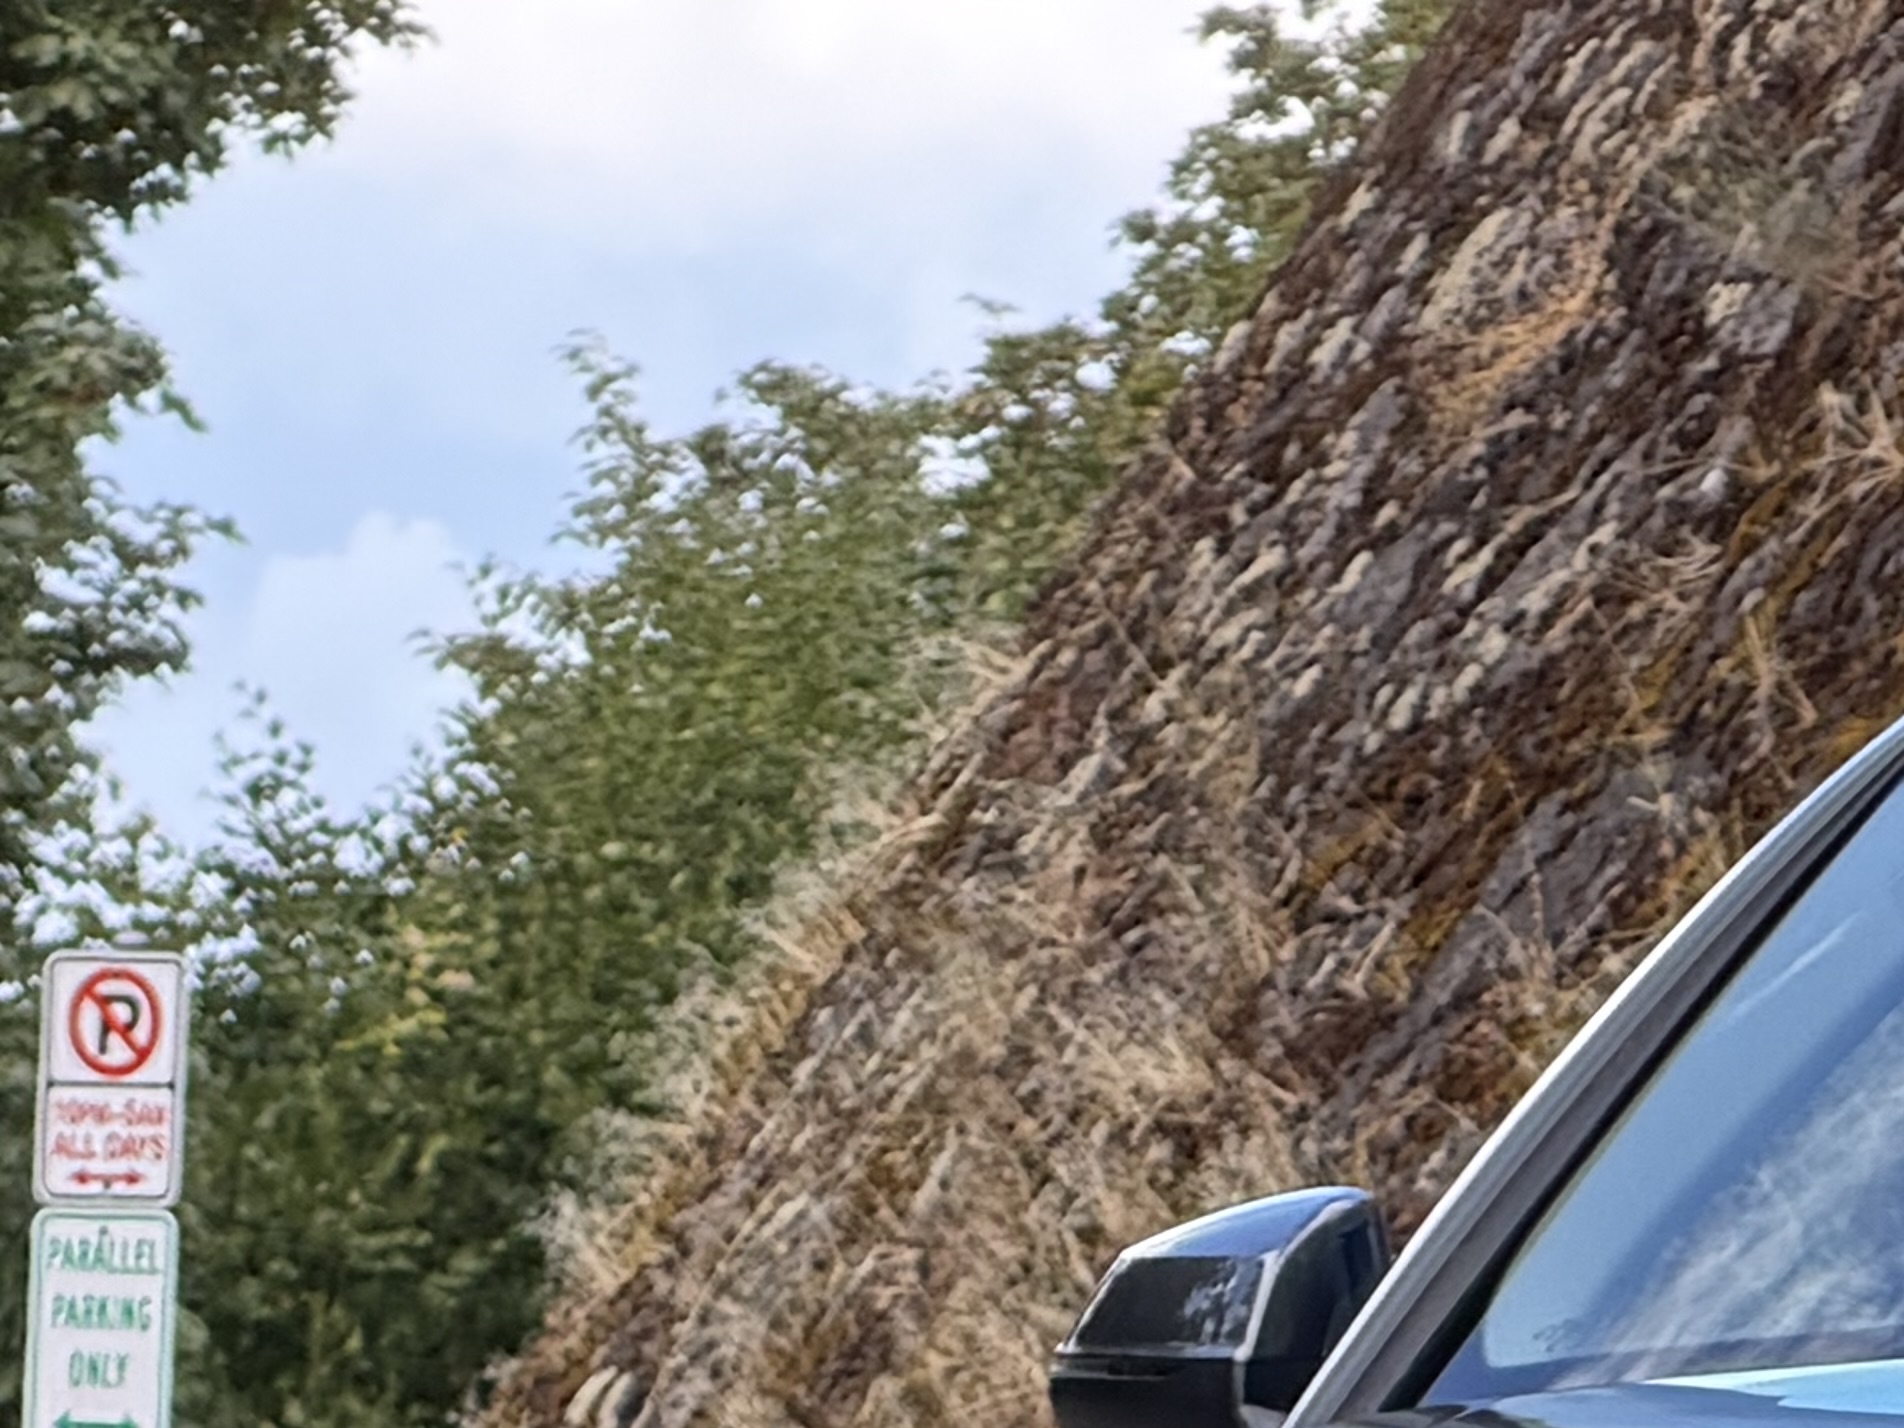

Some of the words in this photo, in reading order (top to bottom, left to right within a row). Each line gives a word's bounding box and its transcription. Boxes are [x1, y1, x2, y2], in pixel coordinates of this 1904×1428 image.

[50, 1131, 97, 1160] ALL
[102, 1131, 165, 1163] DAYS
[46, 1235, 162, 1275] PARALLEL
[50, 1294, 153, 1332] PARKING
[67, 1349, 130, 1389] ONLY
